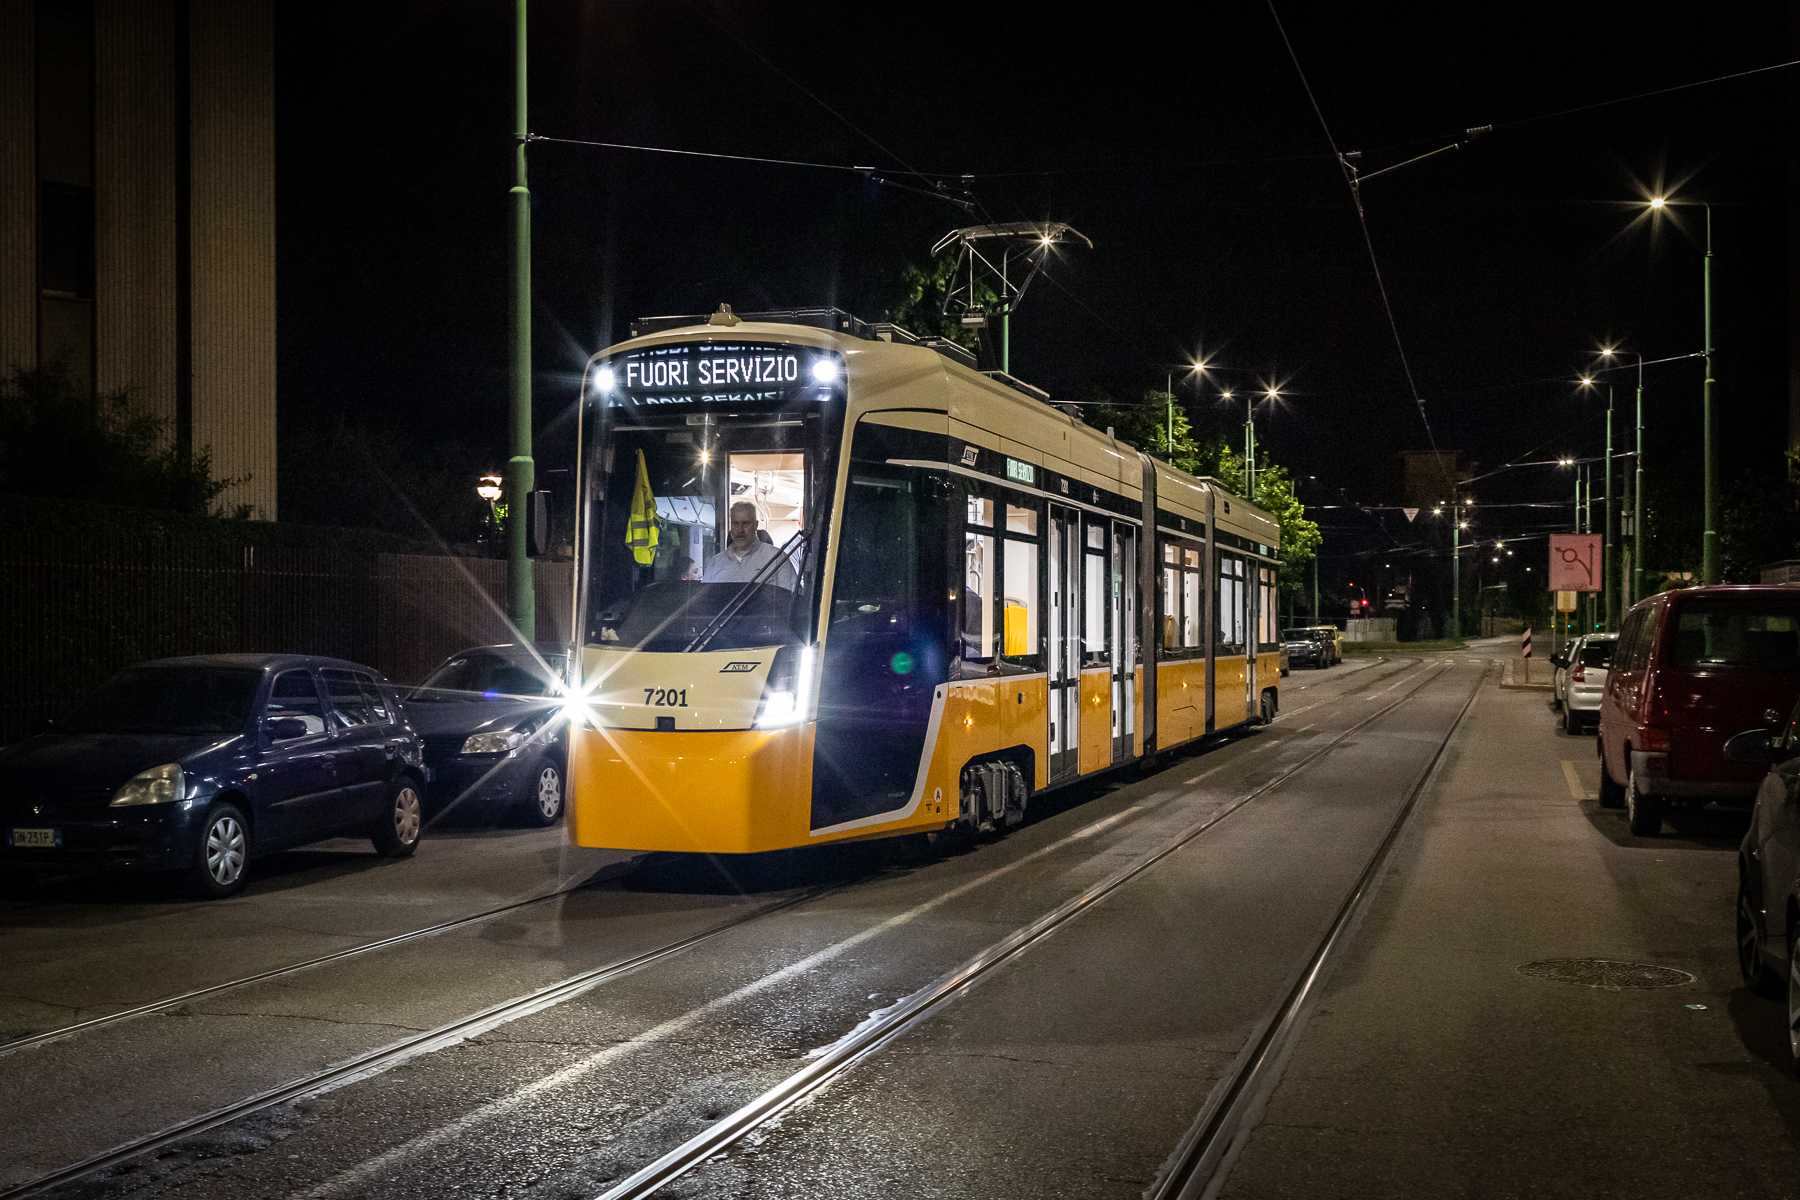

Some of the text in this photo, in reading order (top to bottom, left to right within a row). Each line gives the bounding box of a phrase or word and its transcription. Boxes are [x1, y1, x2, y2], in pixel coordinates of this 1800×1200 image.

[627, 356, 798, 387] FUORI SERVIZIO
[644, 688, 688, 707] 7201
